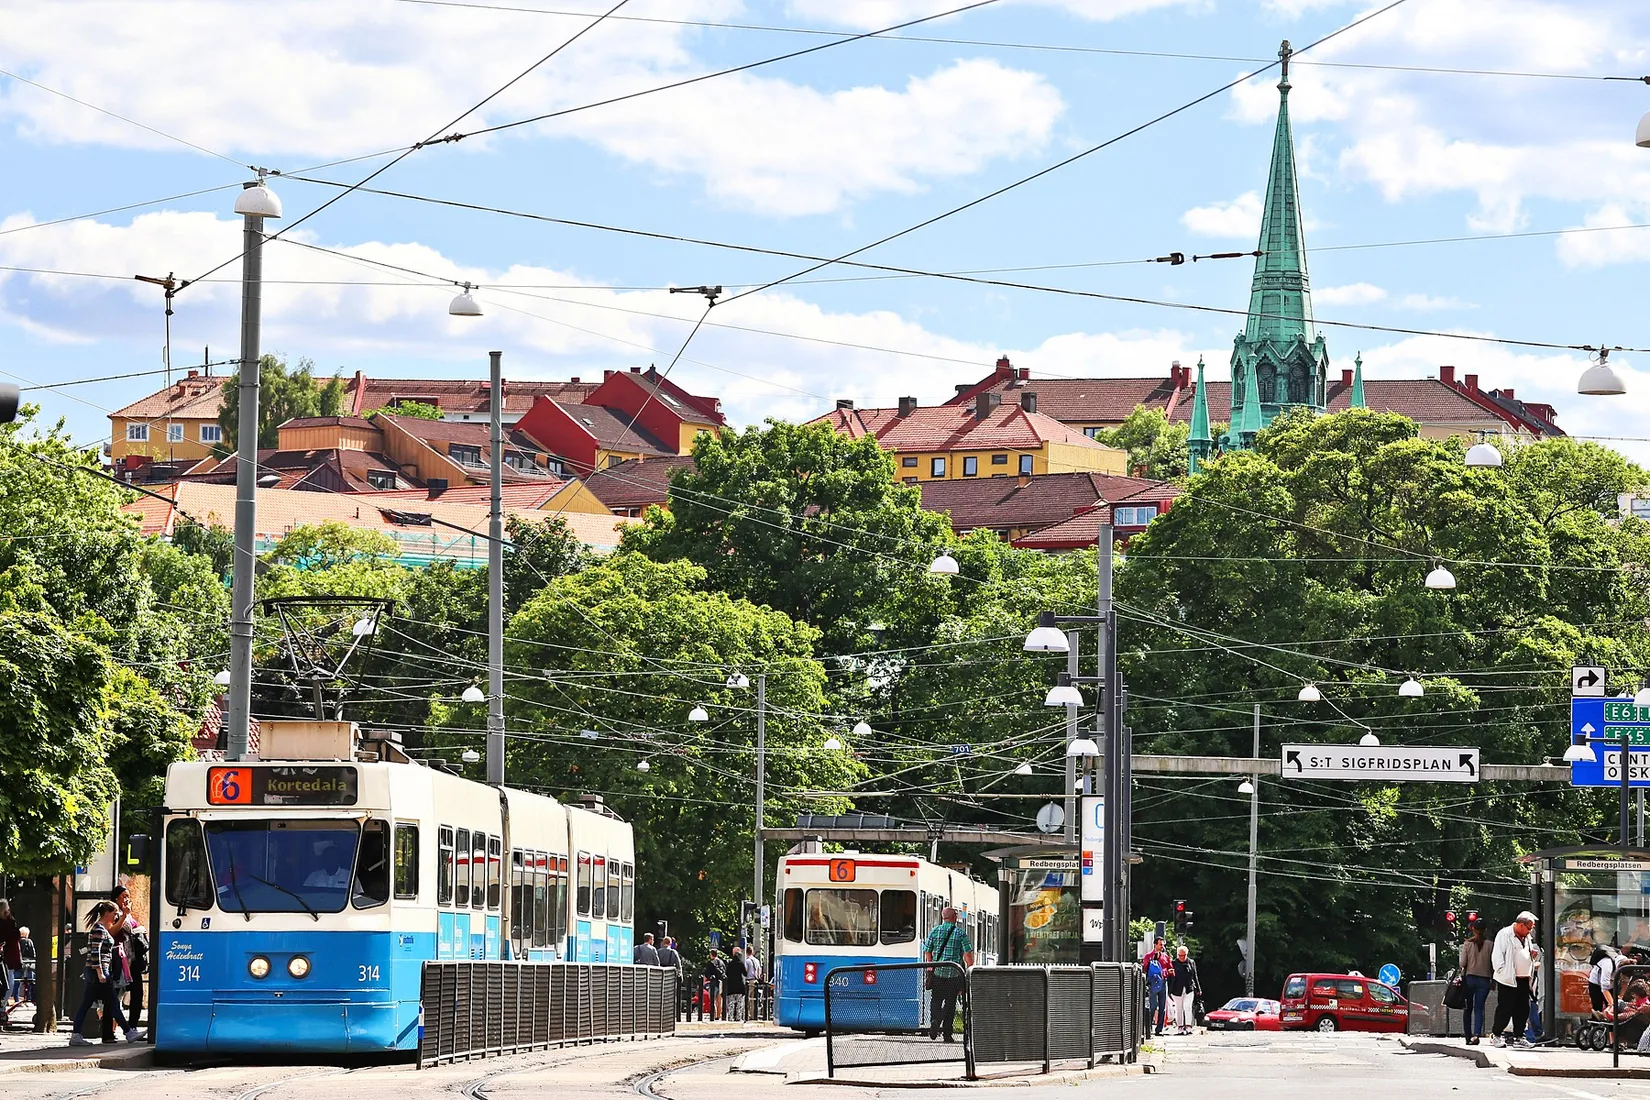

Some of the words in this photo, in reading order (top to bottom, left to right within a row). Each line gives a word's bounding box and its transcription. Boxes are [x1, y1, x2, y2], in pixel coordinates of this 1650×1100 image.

[1612, 707, 1631, 718] E6
[954, 745, 970, 753] 701
[1310, 757, 1332, 768] S:T
[1342, 757, 1451, 770] SIGFRIDSPLAN
[1608, 754, 1649, 765] CNT
[222, 771, 240, 800] 6
[268, 778, 347, 792] Kortedala
[836, 861, 848, 879] 6
[1576, 860, 1642, 870] Redbergsplatsen
[178, 965, 201, 982] 314
[358, 965, 380, 982] 314
